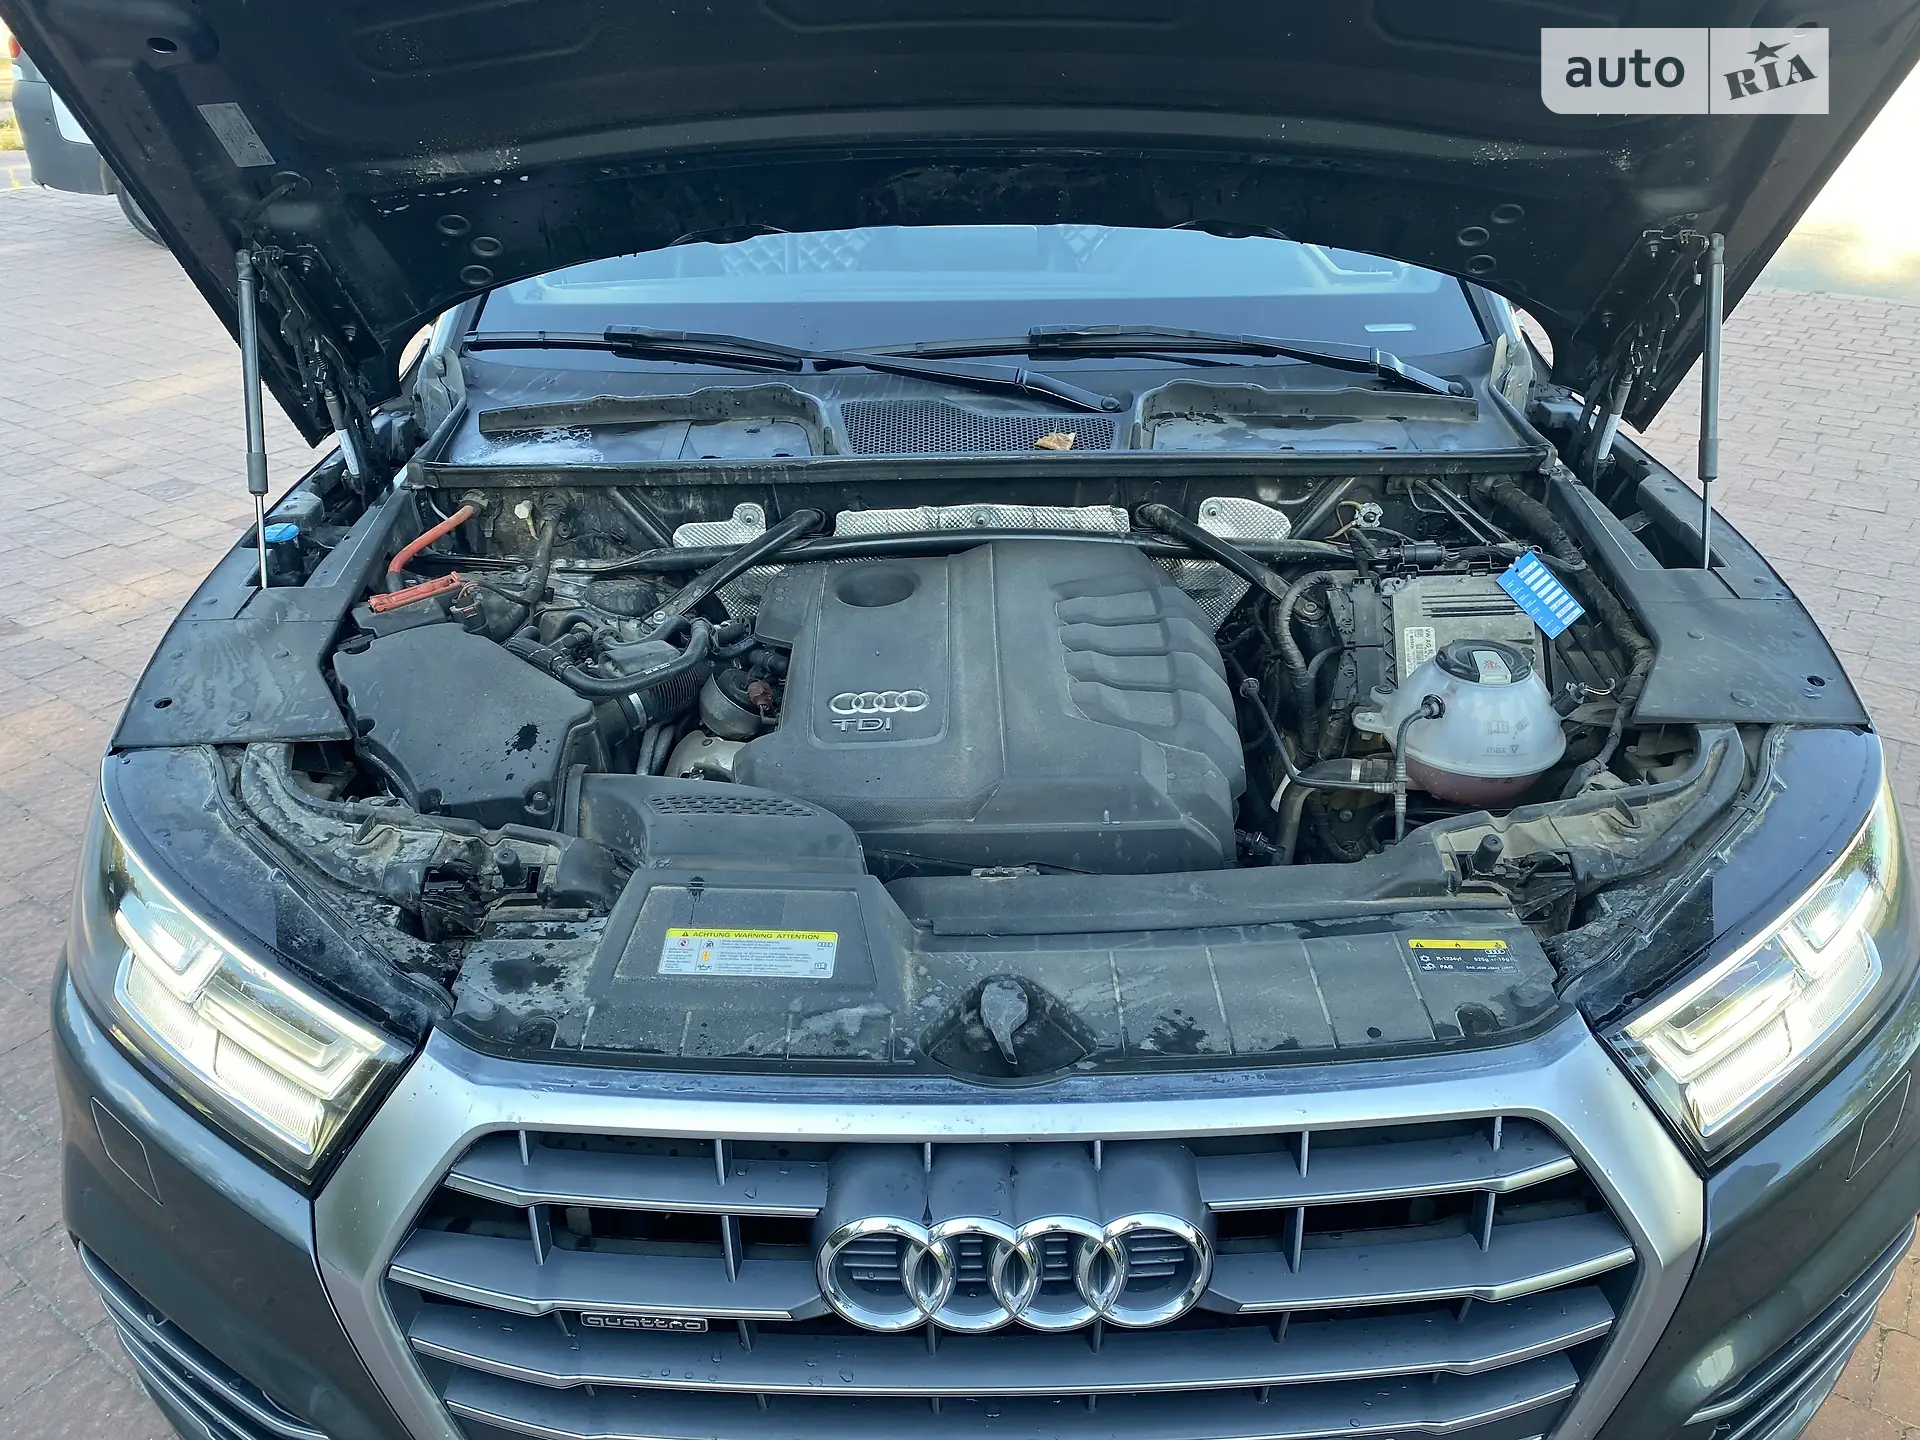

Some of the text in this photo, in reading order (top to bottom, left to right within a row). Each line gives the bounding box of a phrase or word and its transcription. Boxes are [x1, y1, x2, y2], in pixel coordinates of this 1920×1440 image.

[831, 717, 892, 732] TDI
[1486, 746, 1507, 754] max
[586, 1316, 701, 1330] quattro
